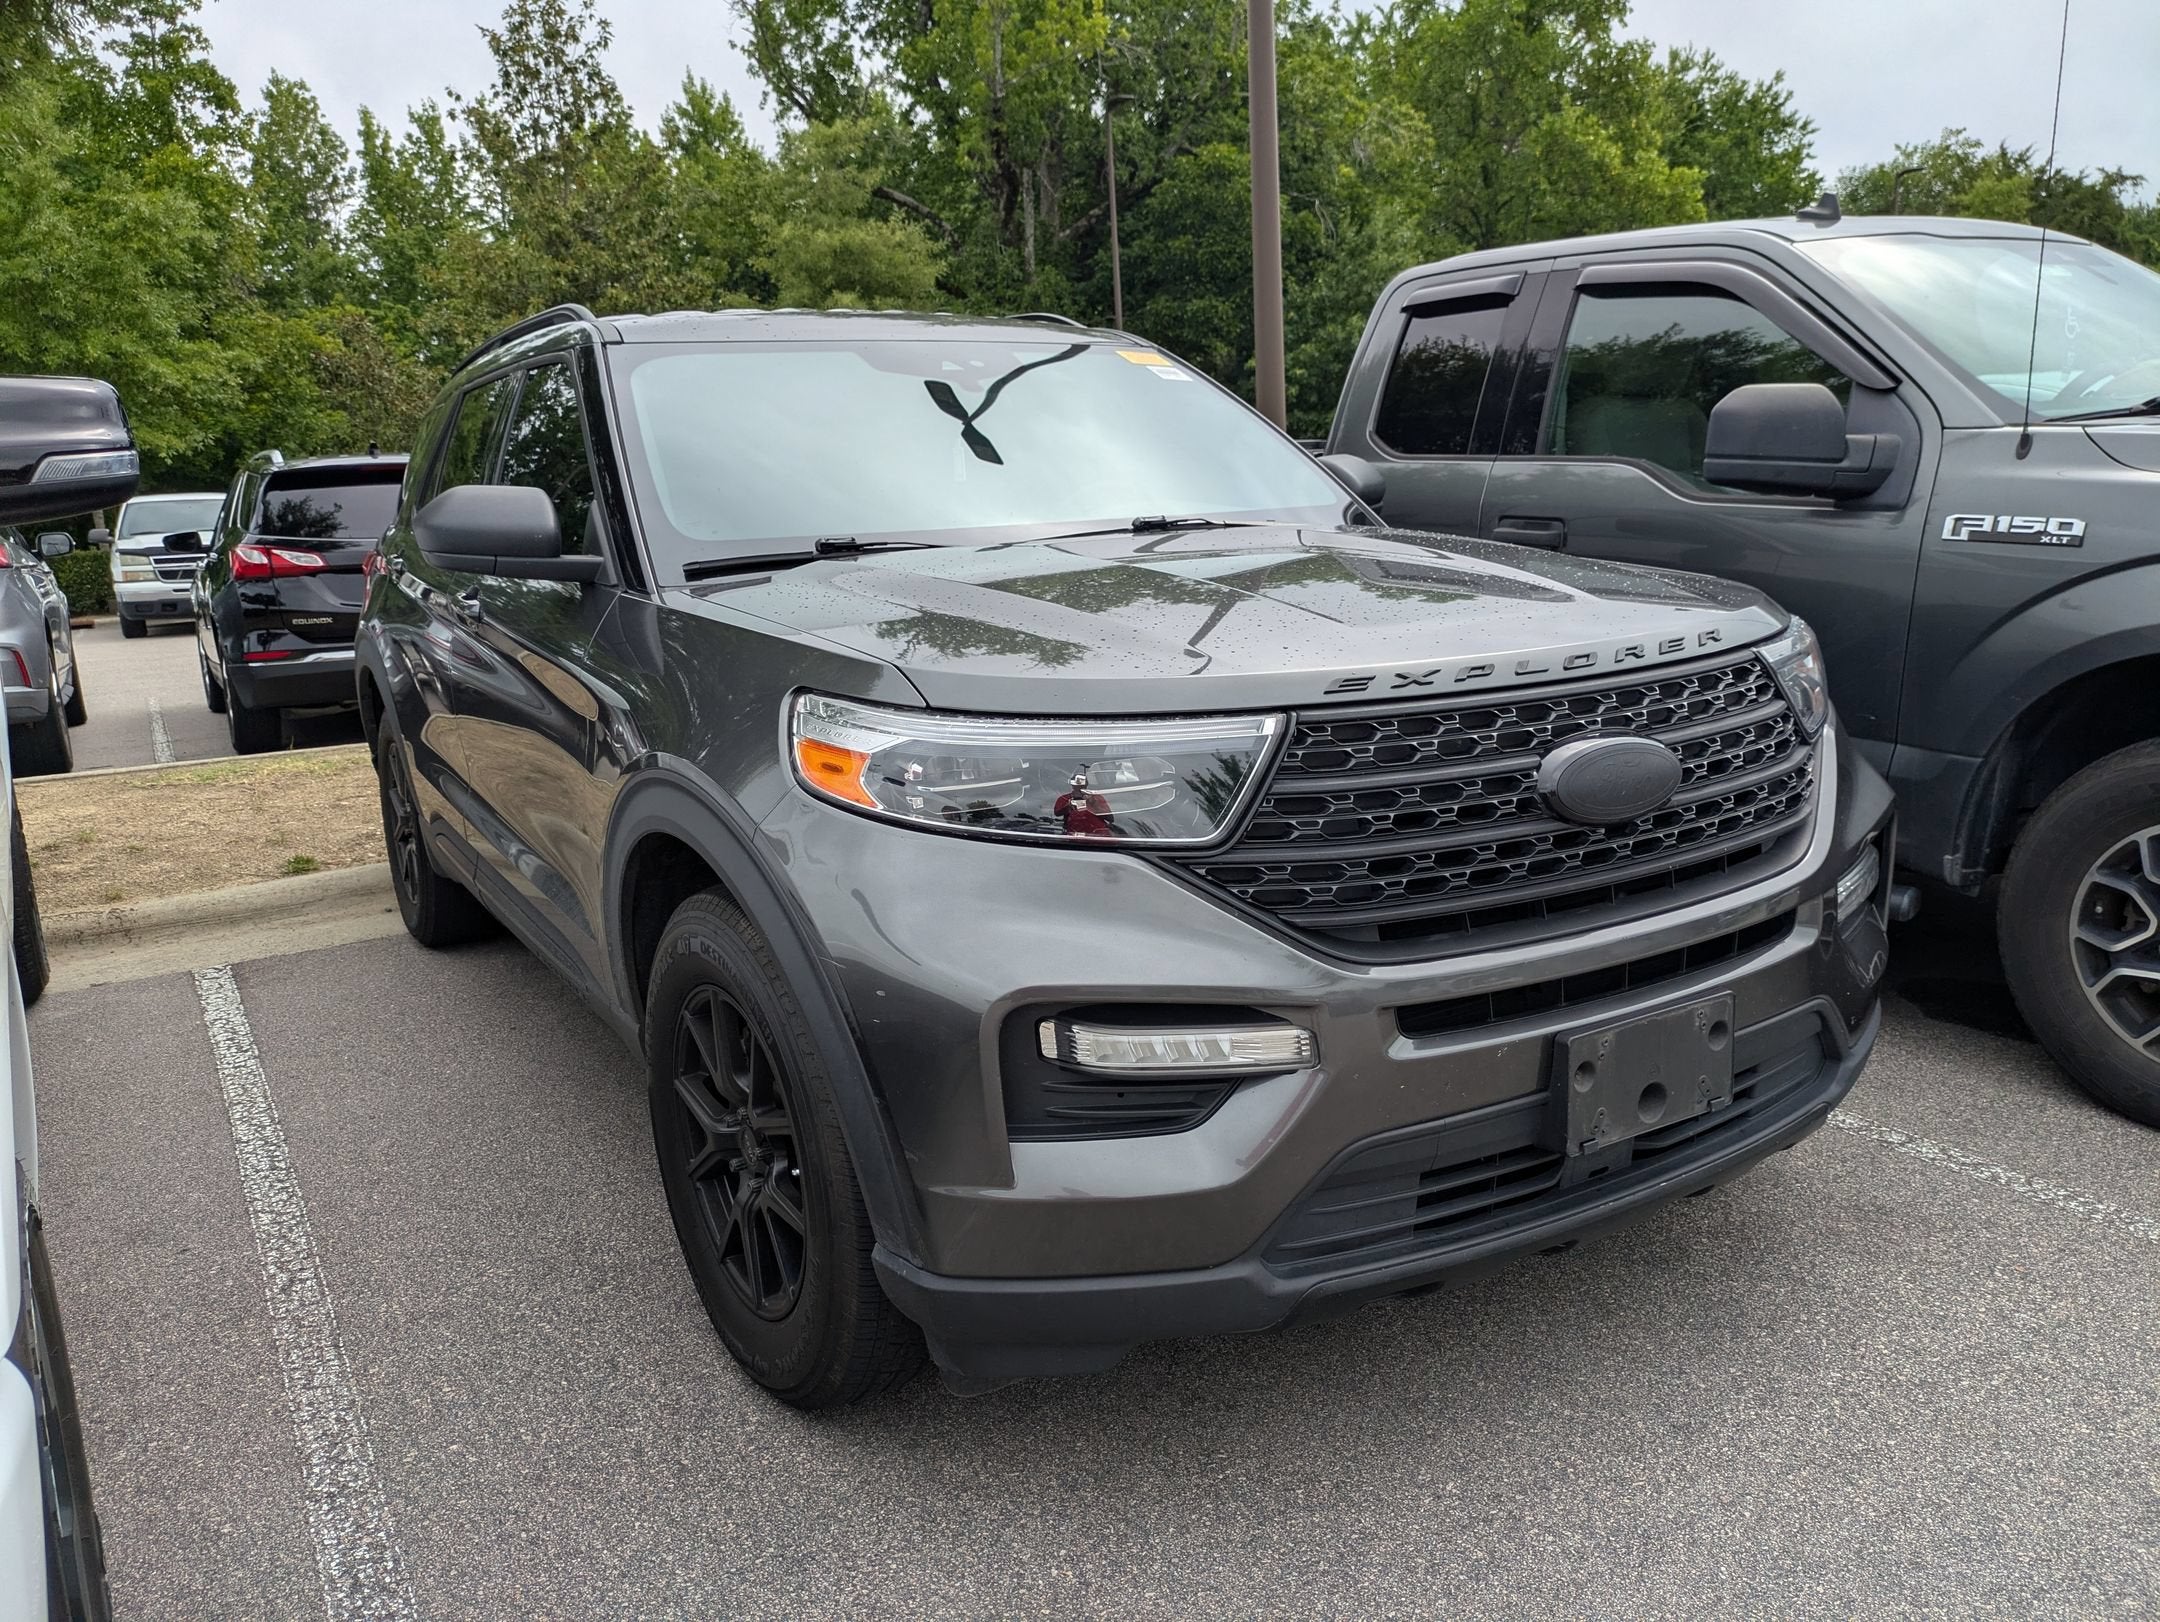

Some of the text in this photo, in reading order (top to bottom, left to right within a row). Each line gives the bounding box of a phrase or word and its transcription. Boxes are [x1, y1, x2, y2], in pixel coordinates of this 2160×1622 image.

[2040, 535, 2071, 544] XLT
[292, 617, 333, 625] EQUINOX
[1323, 628, 1723, 695] EXPLORER
